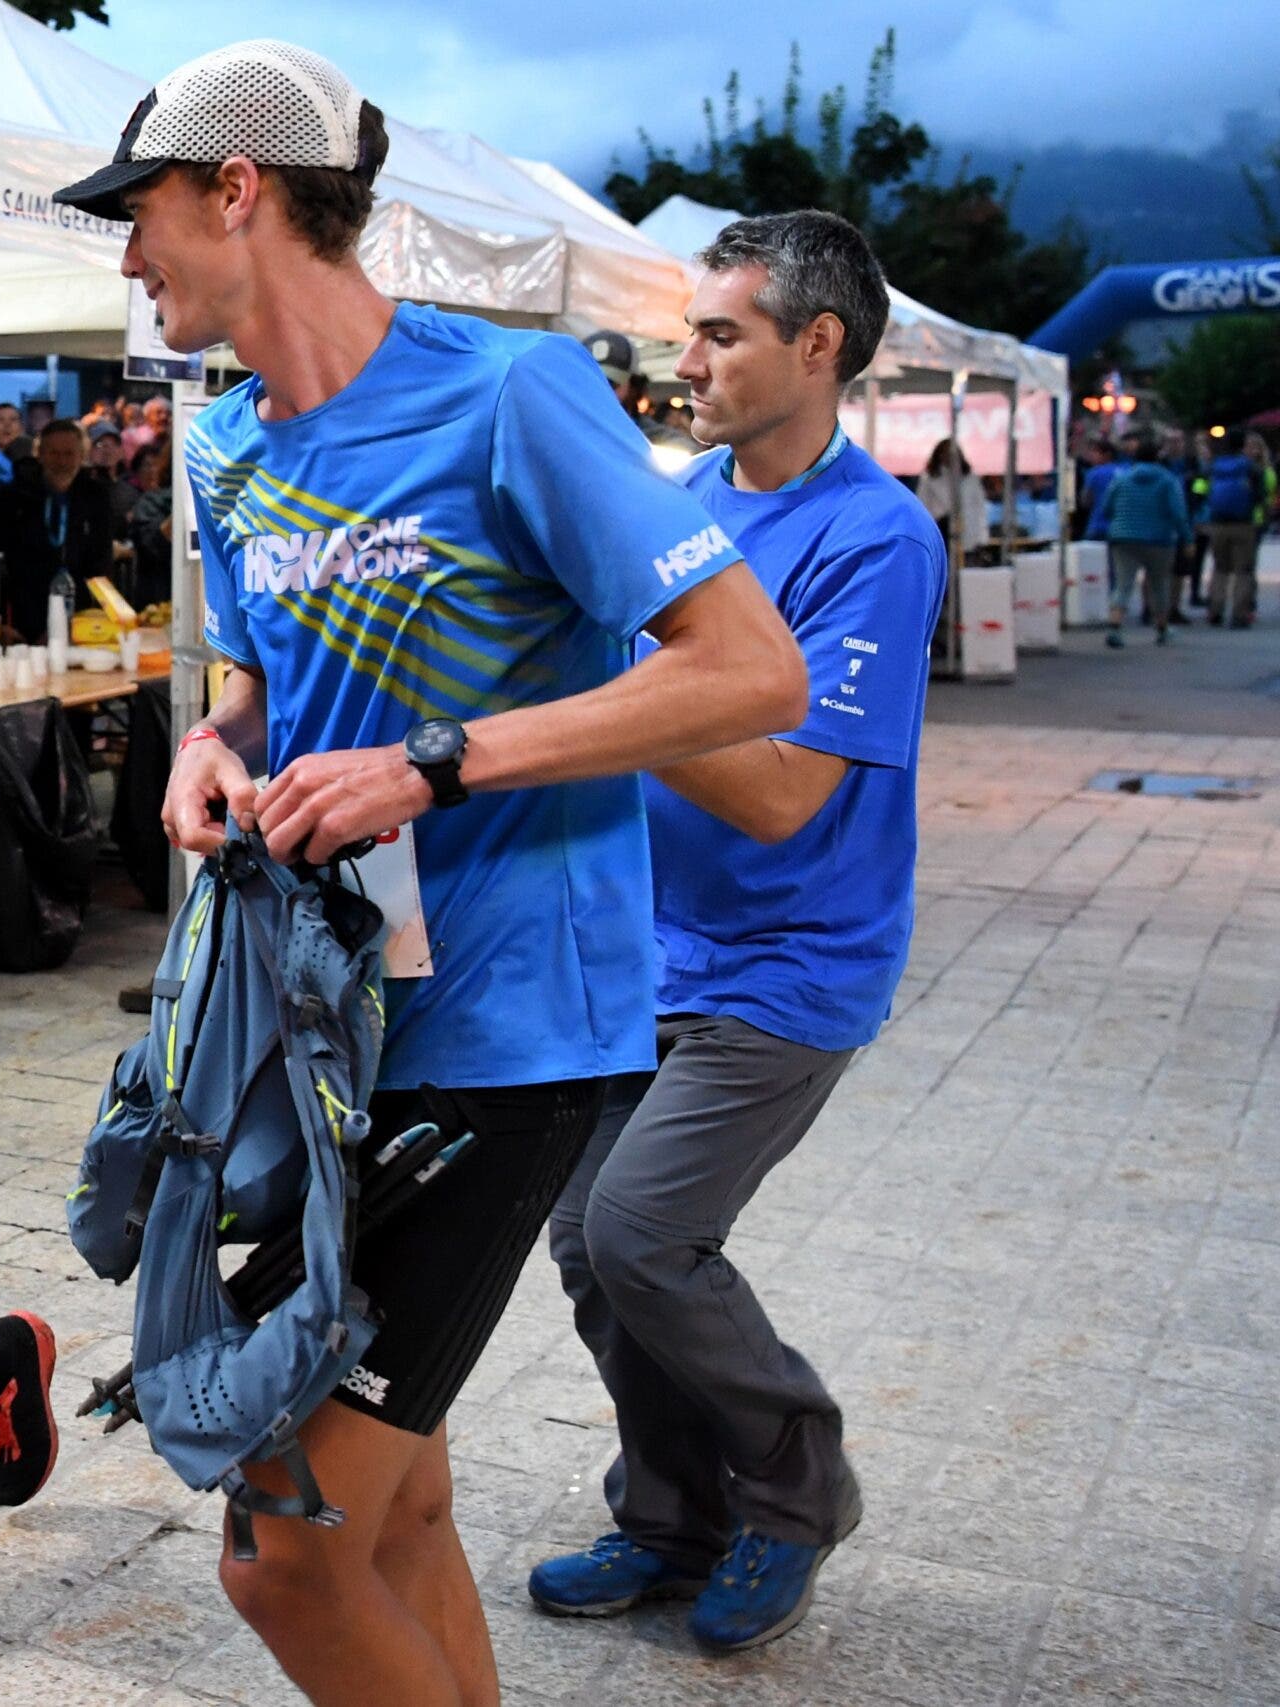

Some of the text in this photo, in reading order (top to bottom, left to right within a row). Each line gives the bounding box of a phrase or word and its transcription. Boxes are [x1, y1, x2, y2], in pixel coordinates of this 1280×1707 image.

[243, 515, 423, 594] HOKA ONE
[356, 546, 430, 580] ONE
[828, 699, 865, 717] Columbia
[345, 1377, 386, 1406] ONE
[350, 1364, 391, 1391] ONE
